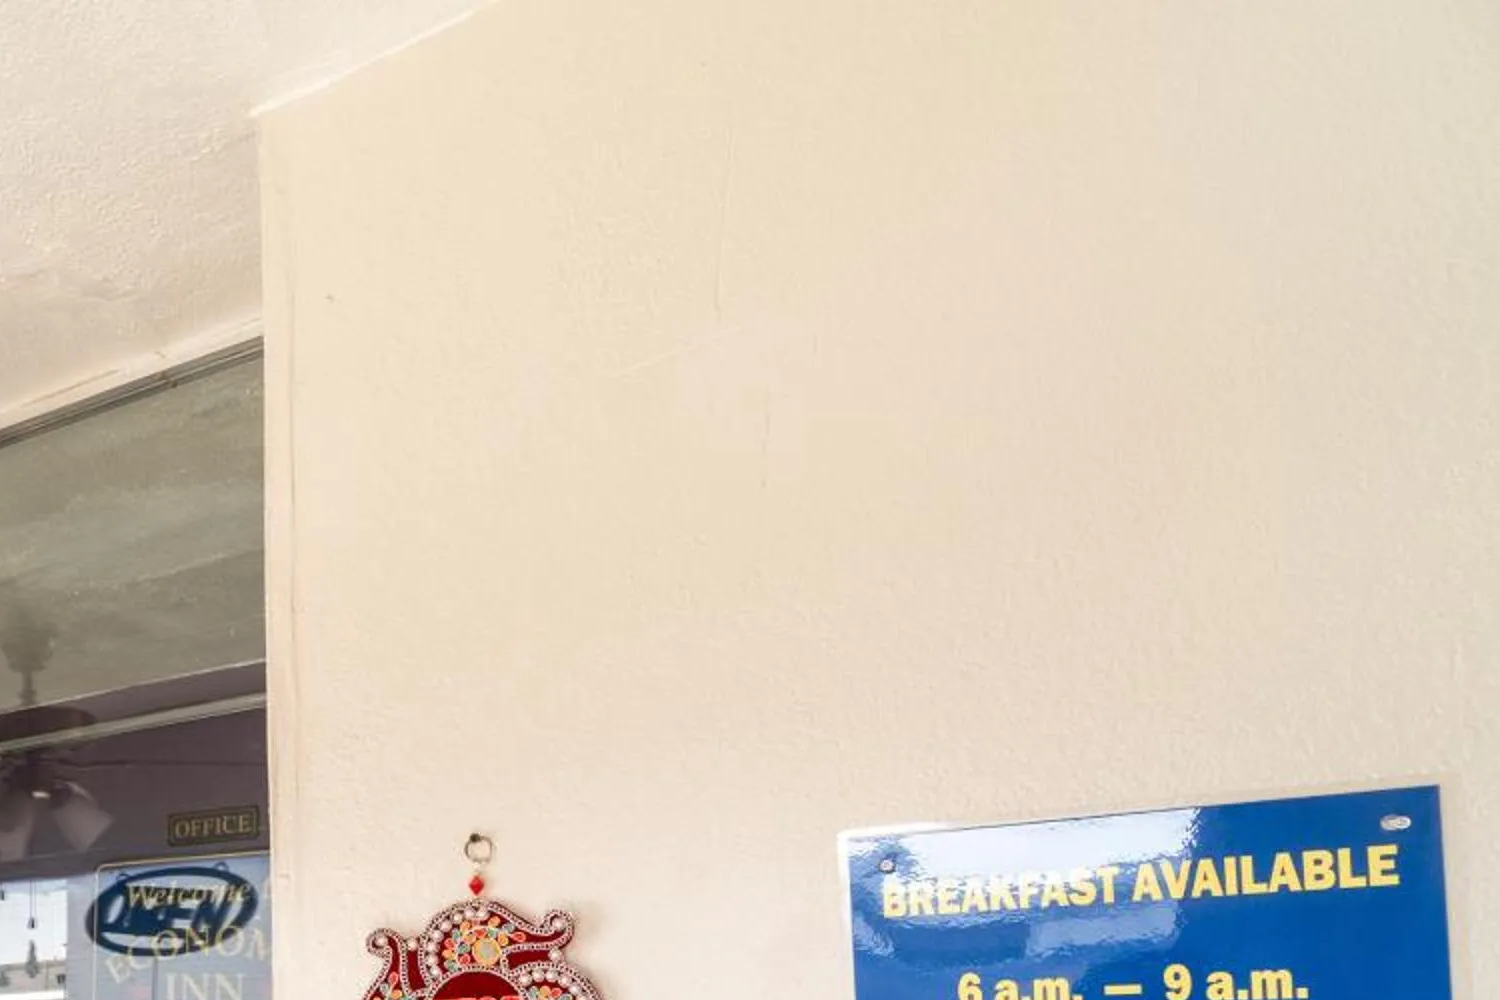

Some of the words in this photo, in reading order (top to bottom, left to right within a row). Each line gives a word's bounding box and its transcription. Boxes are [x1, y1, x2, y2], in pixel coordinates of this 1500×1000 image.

[175, 815, 251, 839] OFFICE
[882, 865, 1120, 918] BREAKFAST
[1132, 845, 1399, 902] AVAILABLE
